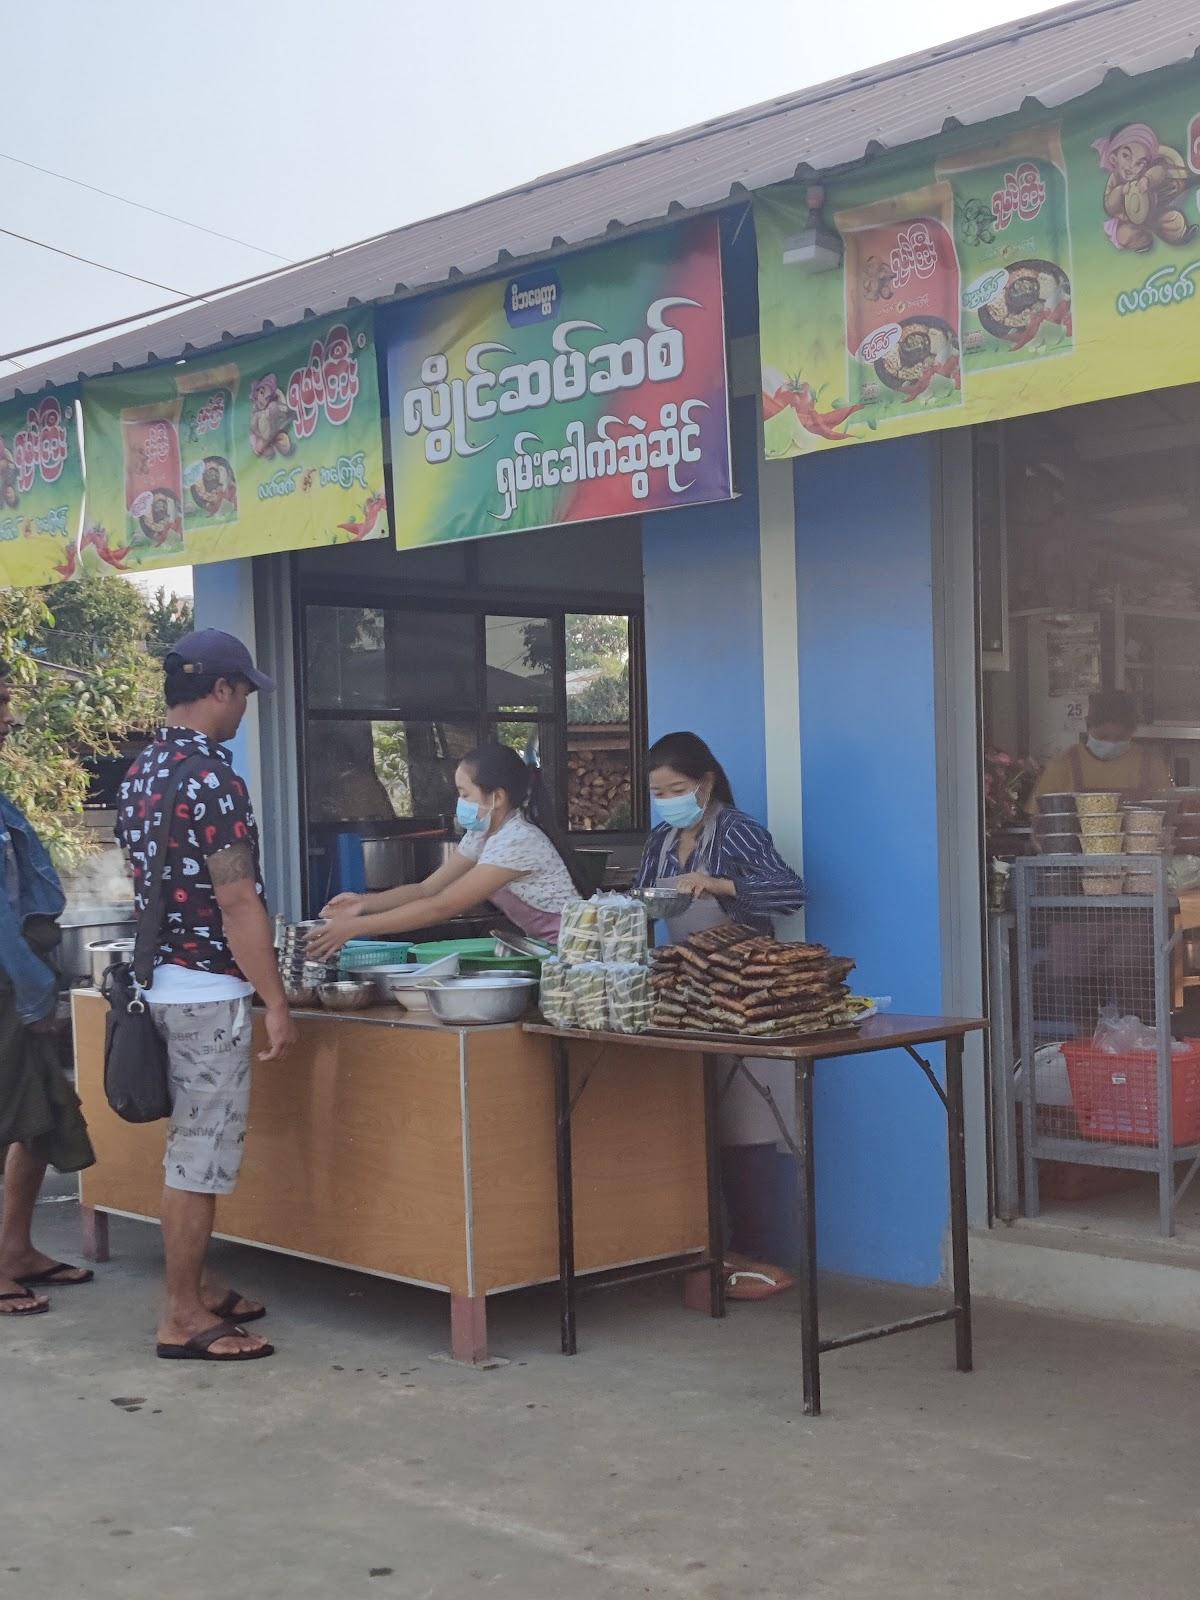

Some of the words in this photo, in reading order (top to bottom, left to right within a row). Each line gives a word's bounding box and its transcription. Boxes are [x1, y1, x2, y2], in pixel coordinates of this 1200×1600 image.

[488, 399, 711, 521] ရှမ်းခေါက်ဆွဲဆိုင်
[1067, 703, 1082, 717] 25
